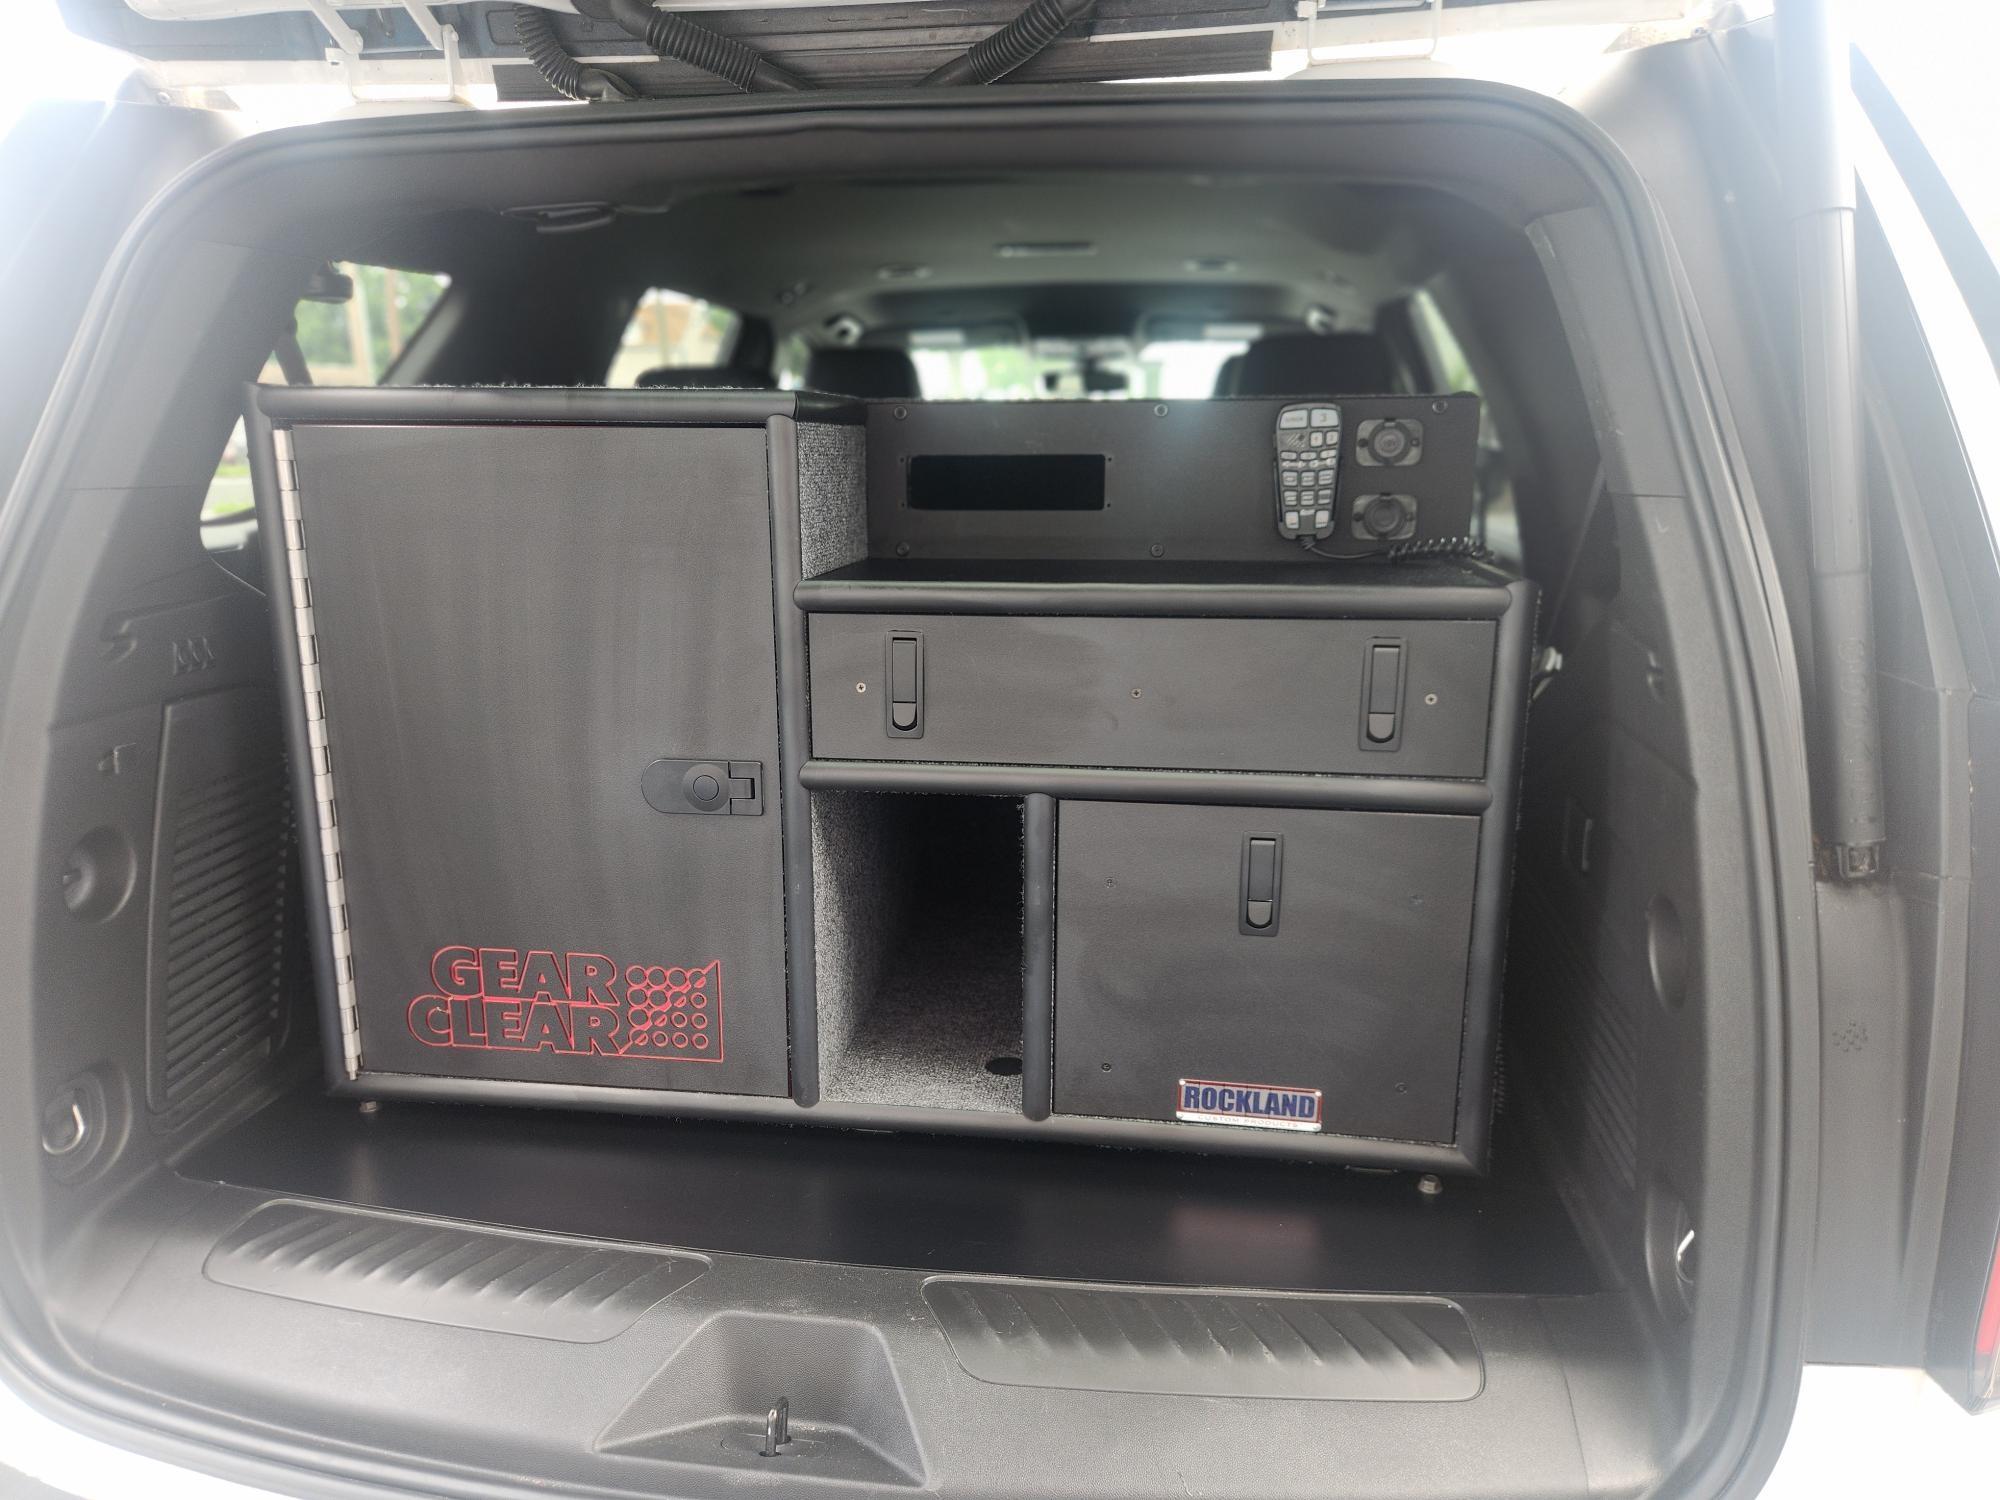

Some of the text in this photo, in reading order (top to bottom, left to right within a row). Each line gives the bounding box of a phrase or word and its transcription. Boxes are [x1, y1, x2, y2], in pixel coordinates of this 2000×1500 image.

[431, 945, 620, 1007] GEAR
[407, 994, 624, 1056] CLEAR
[1183, 1085, 1315, 1118] ROCKLAND
[1198, 1114, 1299, 1128] CUSTOM PRODUCTS
